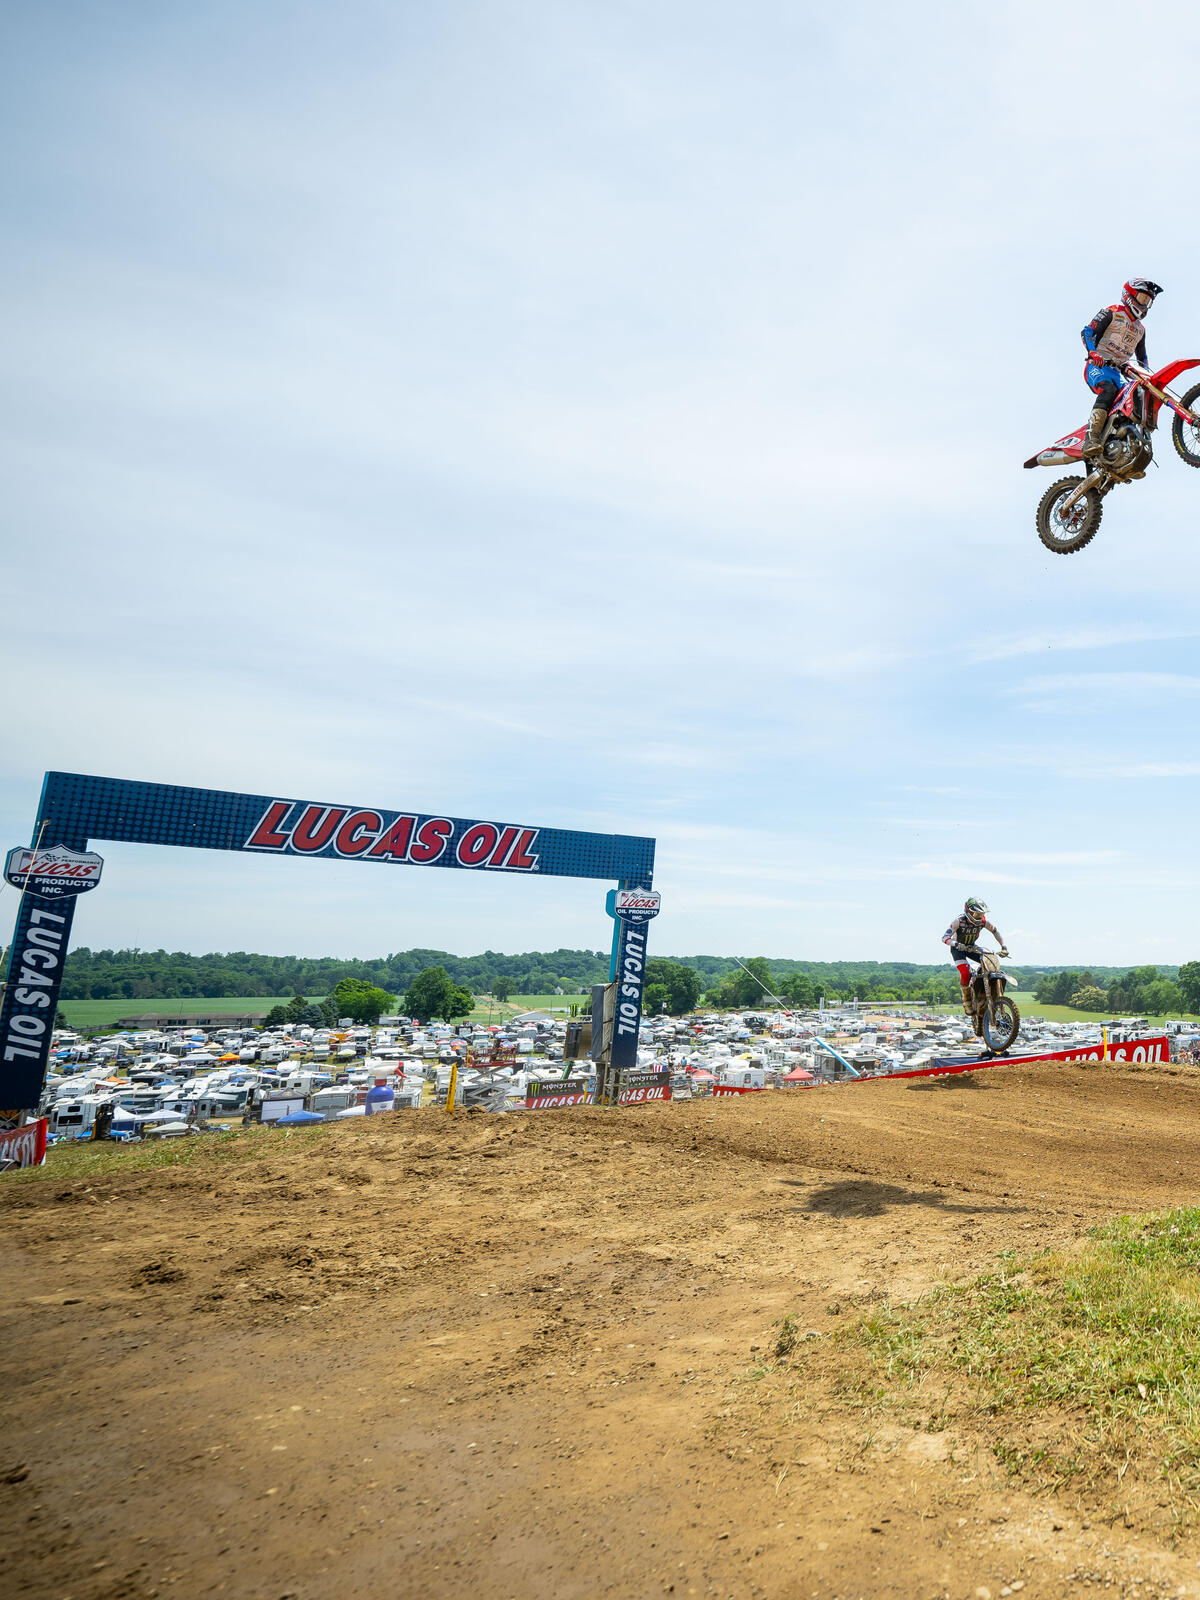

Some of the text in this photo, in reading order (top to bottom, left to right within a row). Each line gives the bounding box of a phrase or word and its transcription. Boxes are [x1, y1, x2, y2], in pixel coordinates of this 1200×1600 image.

[243, 799, 541, 871] LUCAS OIL
[18, 860, 98, 877] LUCAS
[11, 875, 95, 888] OIL PRODUCTS
[41, 886, 65, 894] INC.
[621, 898, 658, 908] LUCAS
[4, 908, 66, 1062] LUCAS OIL
[617, 930, 645, 1035] LUCAS OIL
[630, 1074, 659, 1083] ONSTER
[619, 1087, 664, 1102] CAS OIL
